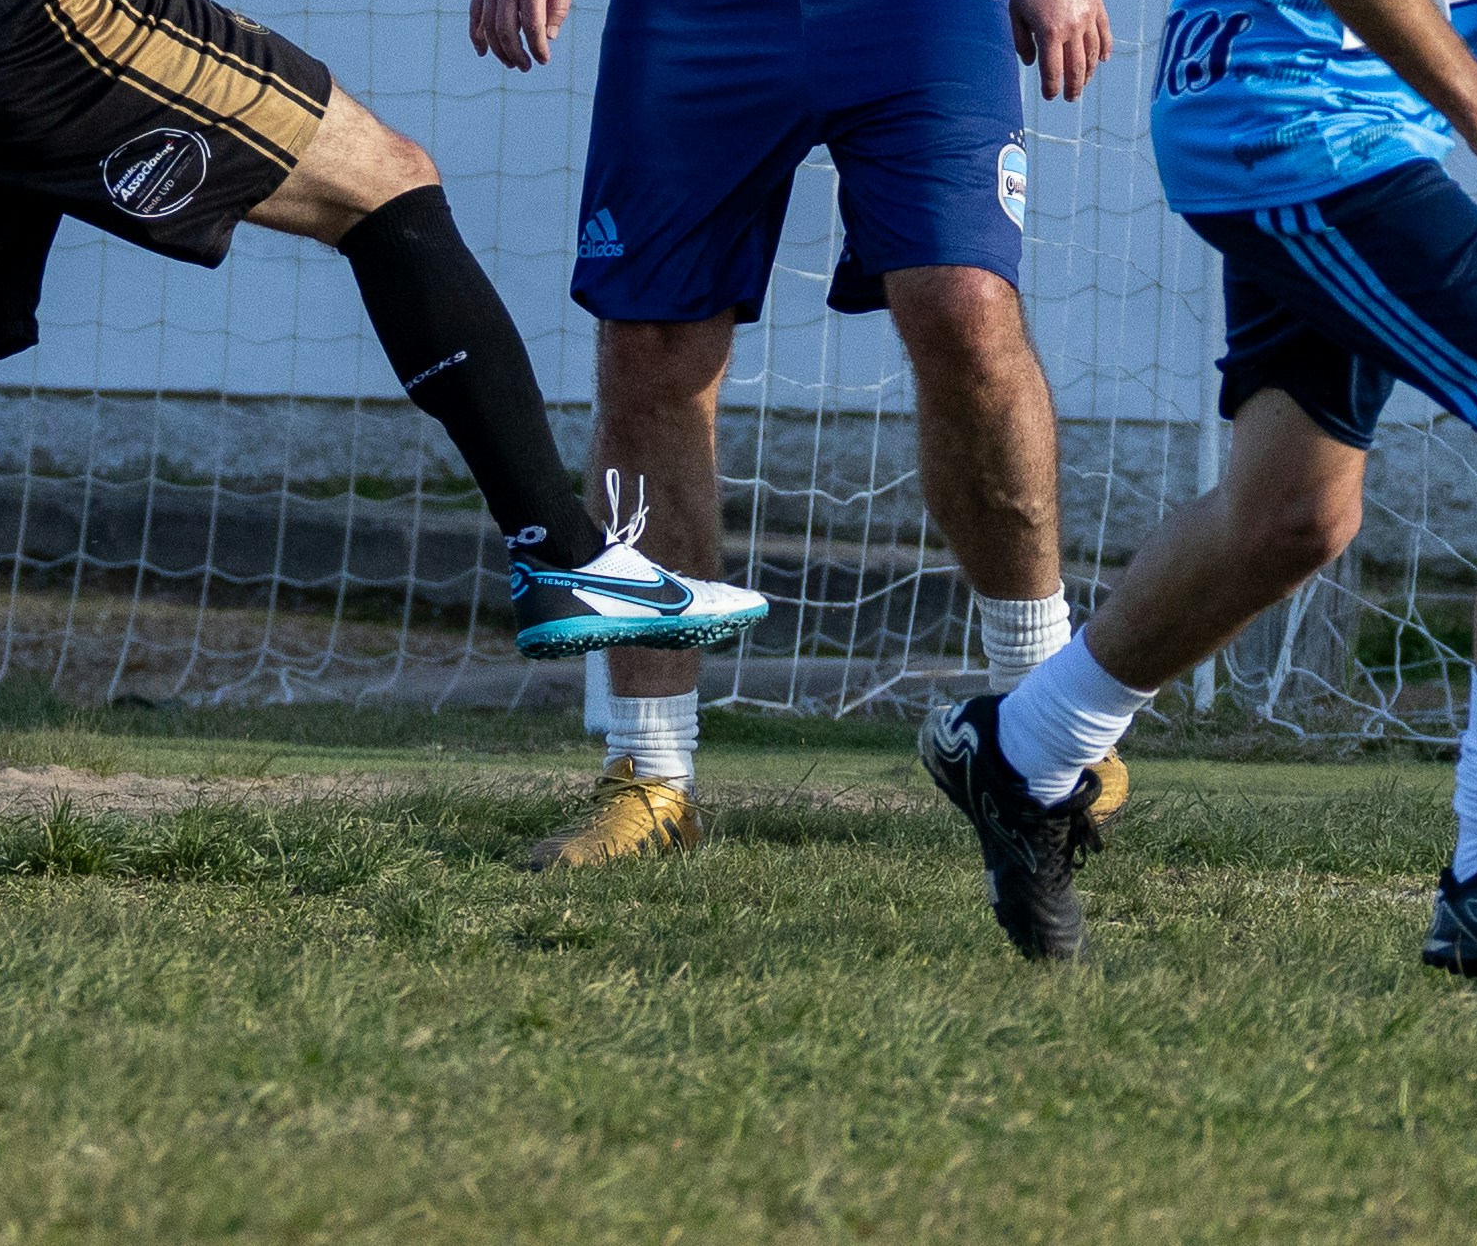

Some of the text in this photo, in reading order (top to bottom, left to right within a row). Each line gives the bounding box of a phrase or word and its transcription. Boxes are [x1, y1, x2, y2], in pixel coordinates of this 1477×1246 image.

[159, 179, 175, 196] LVD
[578, 240, 624, 258] didas
[536, 577, 580, 588] TIEMPO
